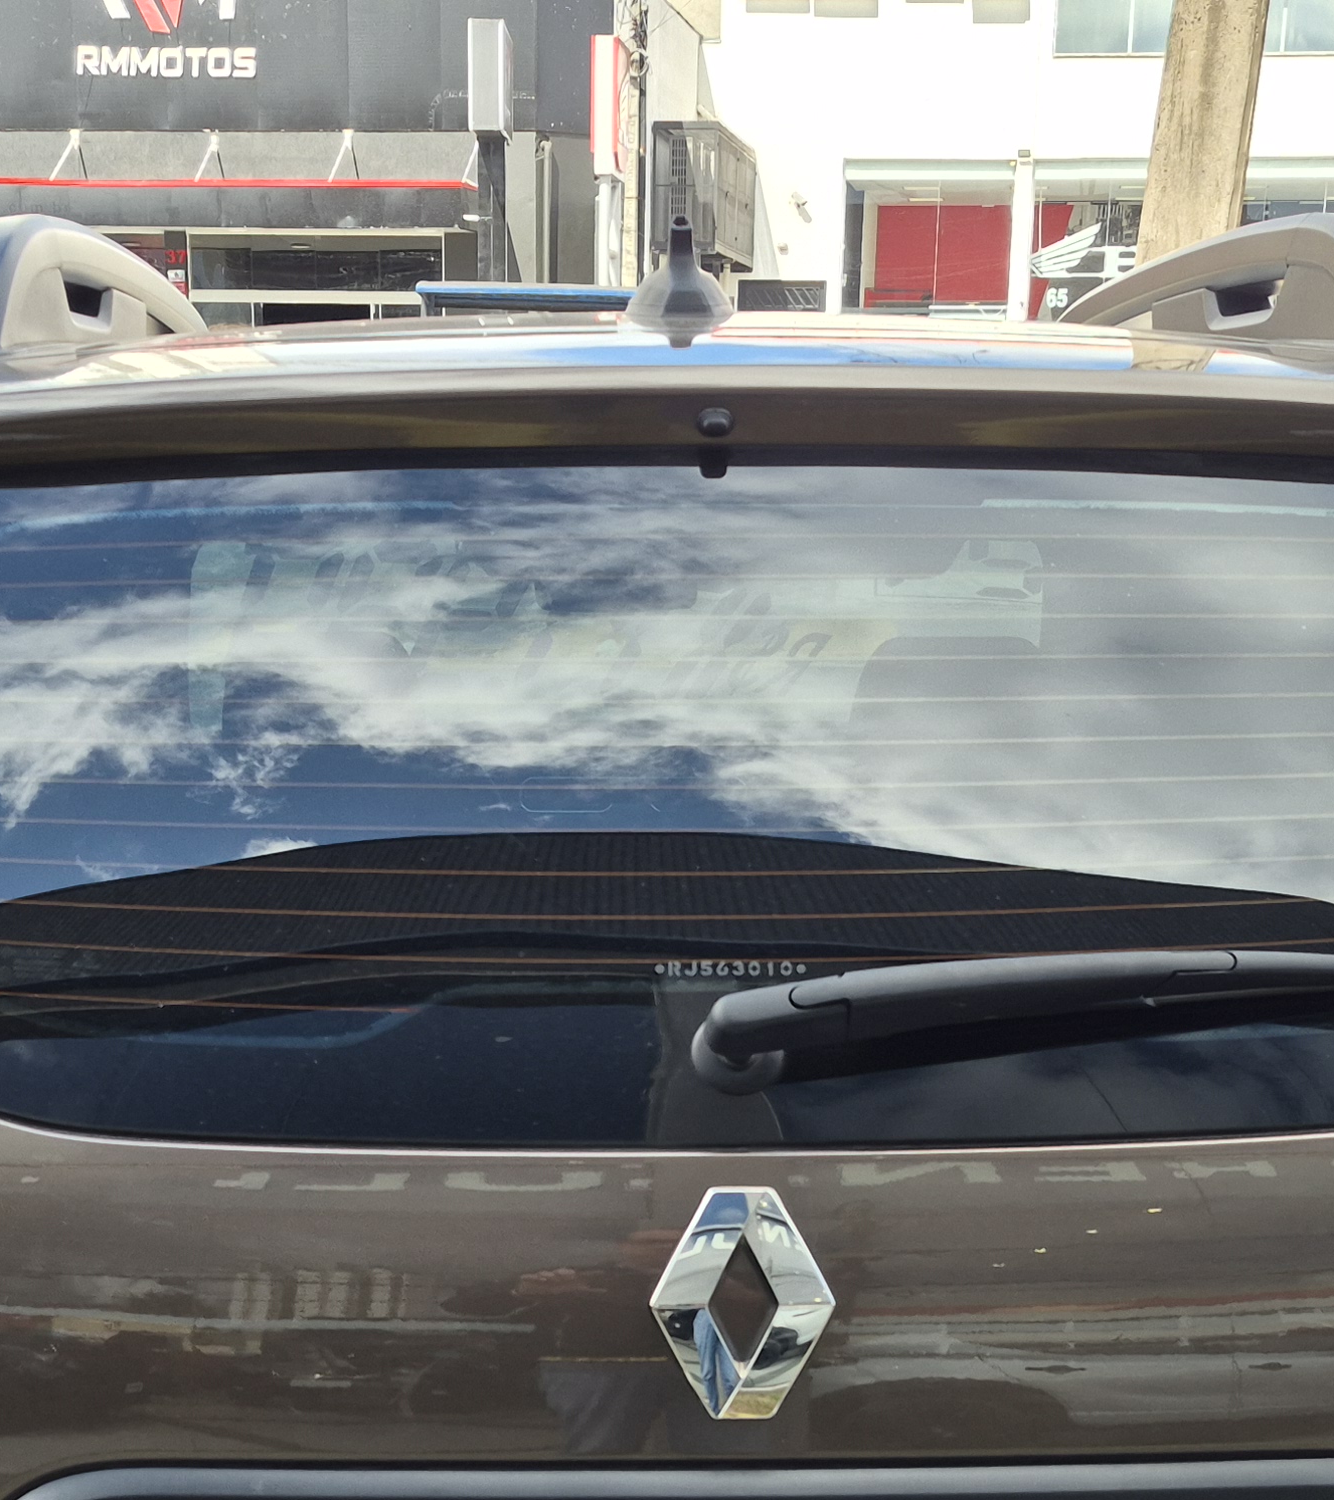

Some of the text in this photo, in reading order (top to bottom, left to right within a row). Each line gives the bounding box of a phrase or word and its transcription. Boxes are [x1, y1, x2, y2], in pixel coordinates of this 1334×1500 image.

[76, 45, 257, 78] RMMOTOS
[165, 249, 187, 264] 37
[1046, 288, 1068, 308] 65
[667, 961, 793, 978] RJ563010
